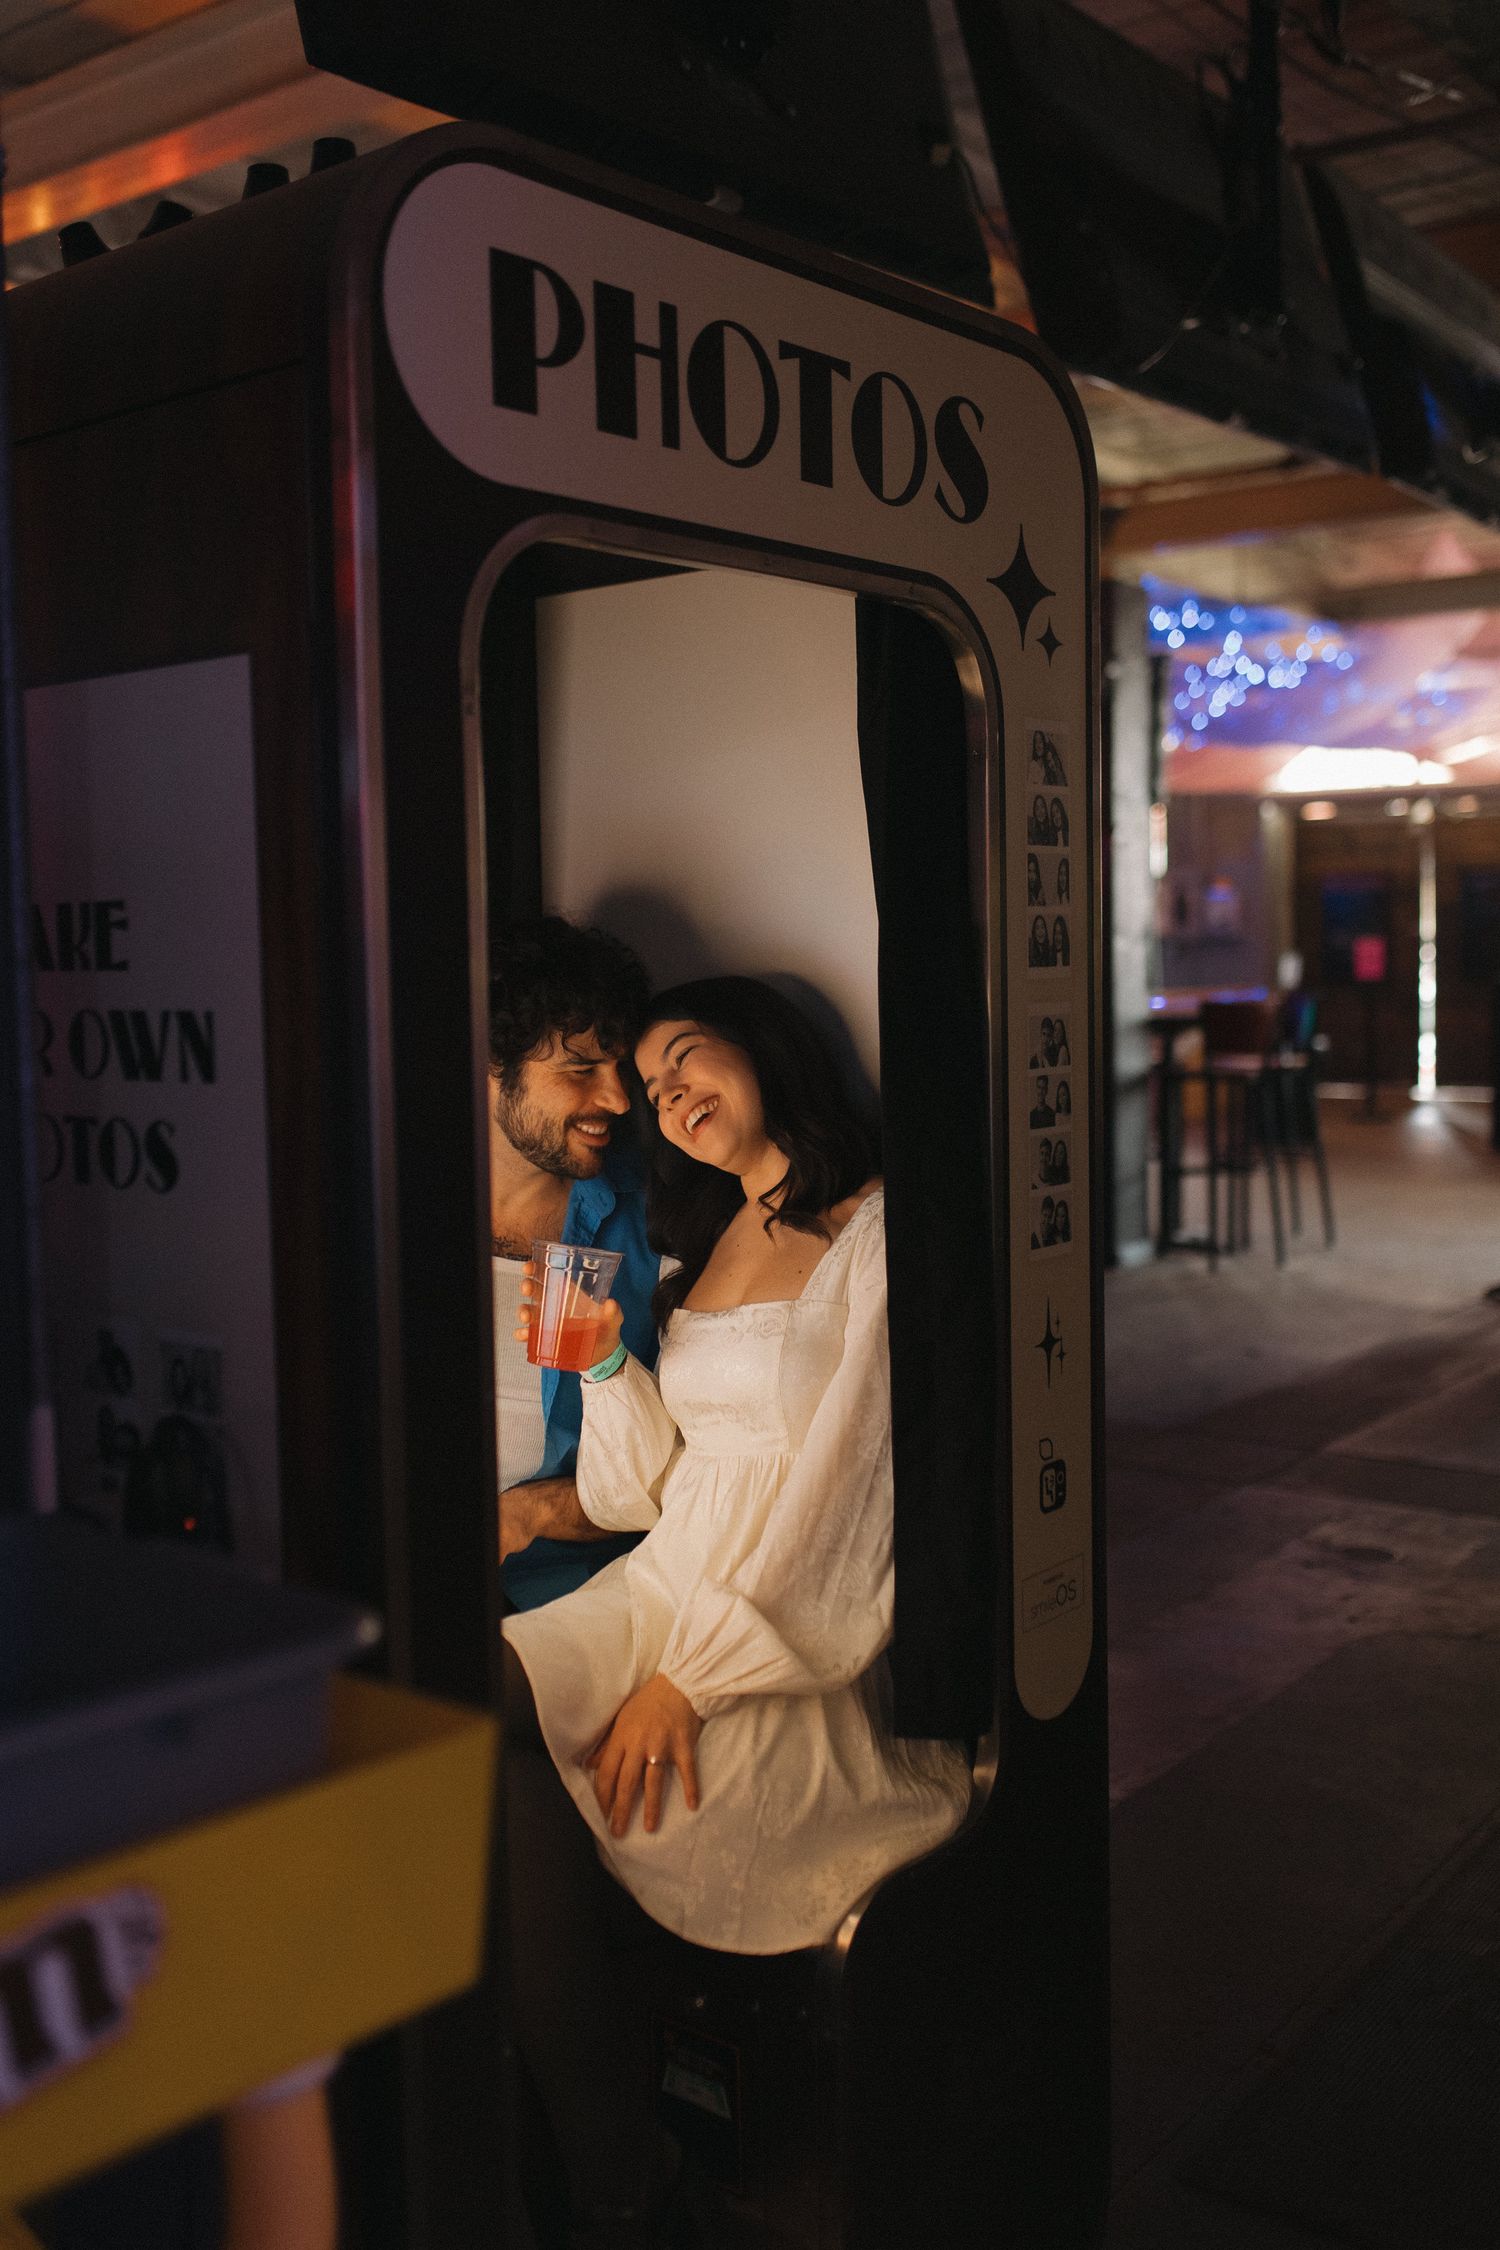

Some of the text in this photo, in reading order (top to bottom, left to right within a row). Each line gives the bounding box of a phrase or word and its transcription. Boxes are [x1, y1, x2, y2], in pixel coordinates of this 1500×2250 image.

[489, 246, 989, 524] PHOTOS
[28, 899, 129, 972] AKE
[67, 1008, 217, 1085] OWN
[38, 1112, 180, 1195] OTOS
